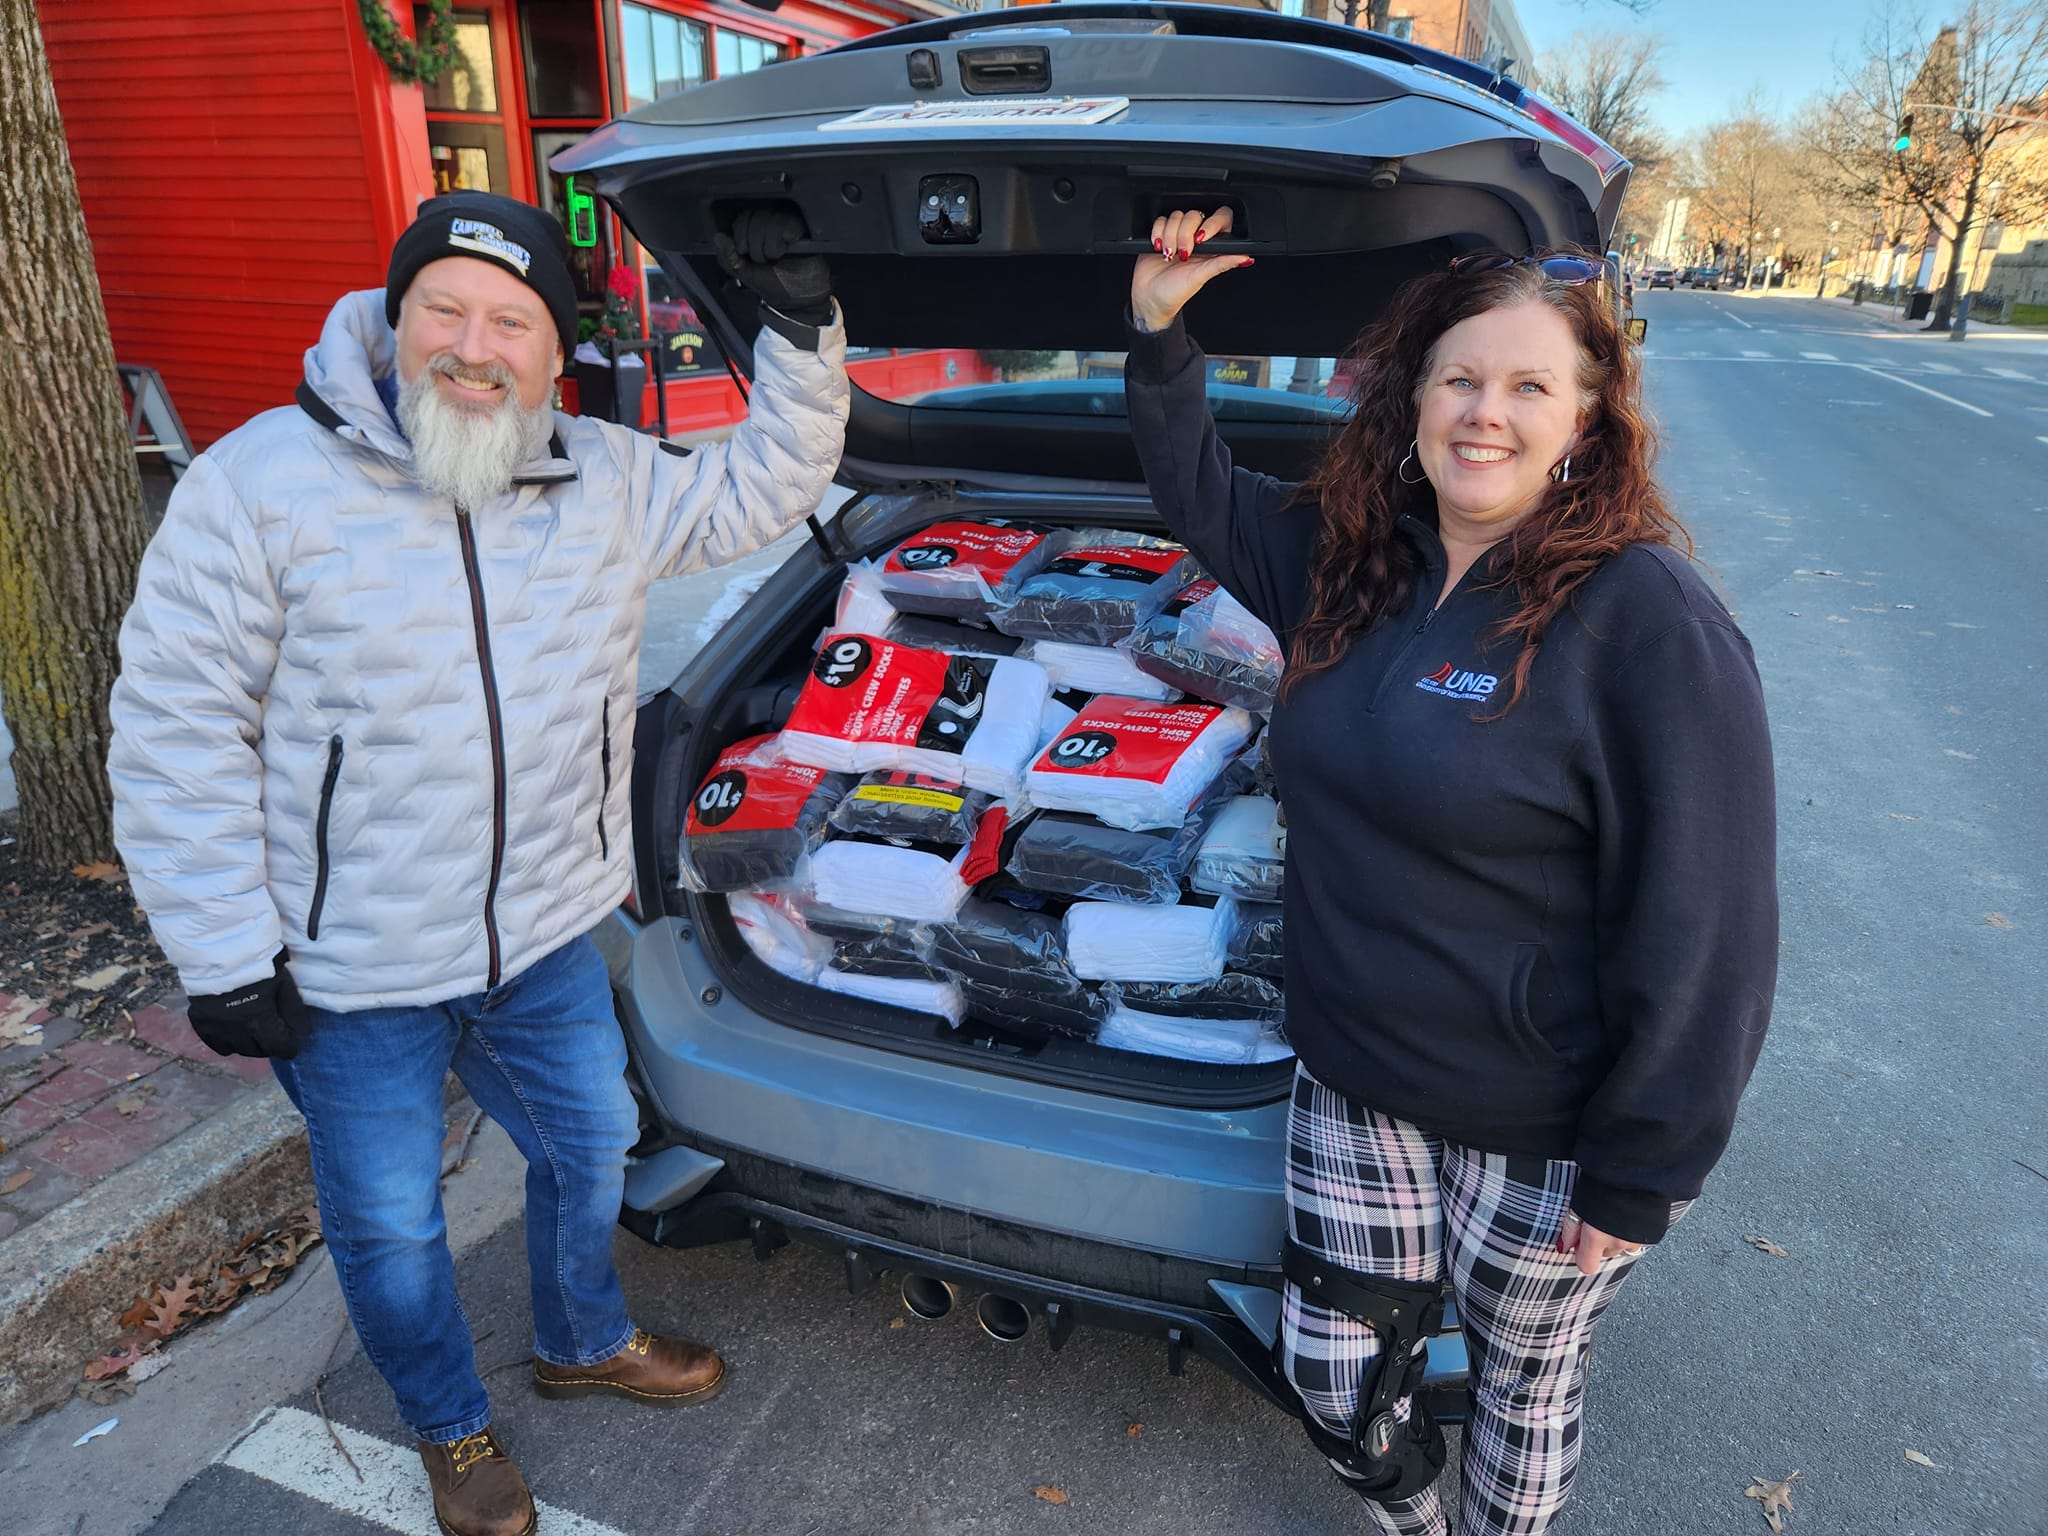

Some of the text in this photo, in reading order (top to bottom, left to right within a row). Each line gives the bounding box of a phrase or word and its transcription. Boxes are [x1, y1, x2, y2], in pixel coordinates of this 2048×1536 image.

[670, 333, 703, 351] JAMESON
[923, 536, 960, 545] SOCKS
[905, 549, 952, 564] $10
[825, 641, 862, 688] $10
[1445, 669, 1498, 693] UNB
[850, 646, 894, 736] 20PK CREW SOCKS
[1123, 711, 1204, 723] CHAUSSETTES
[1176, 709, 1208, 718] 20PK
[1082, 720, 1192, 737] 20PK CREW SOCKS
[1159, 719, 1200, 729] HOMMES
[904, 725, 917, 739] 20
[1158, 734, 1188, 742] MEN'S
[1057, 737, 1108, 756] $10
[788, 765, 818, 778] 20PK
[698, 782, 741, 810] $10
[225, 993, 260, 1008] HEAD
